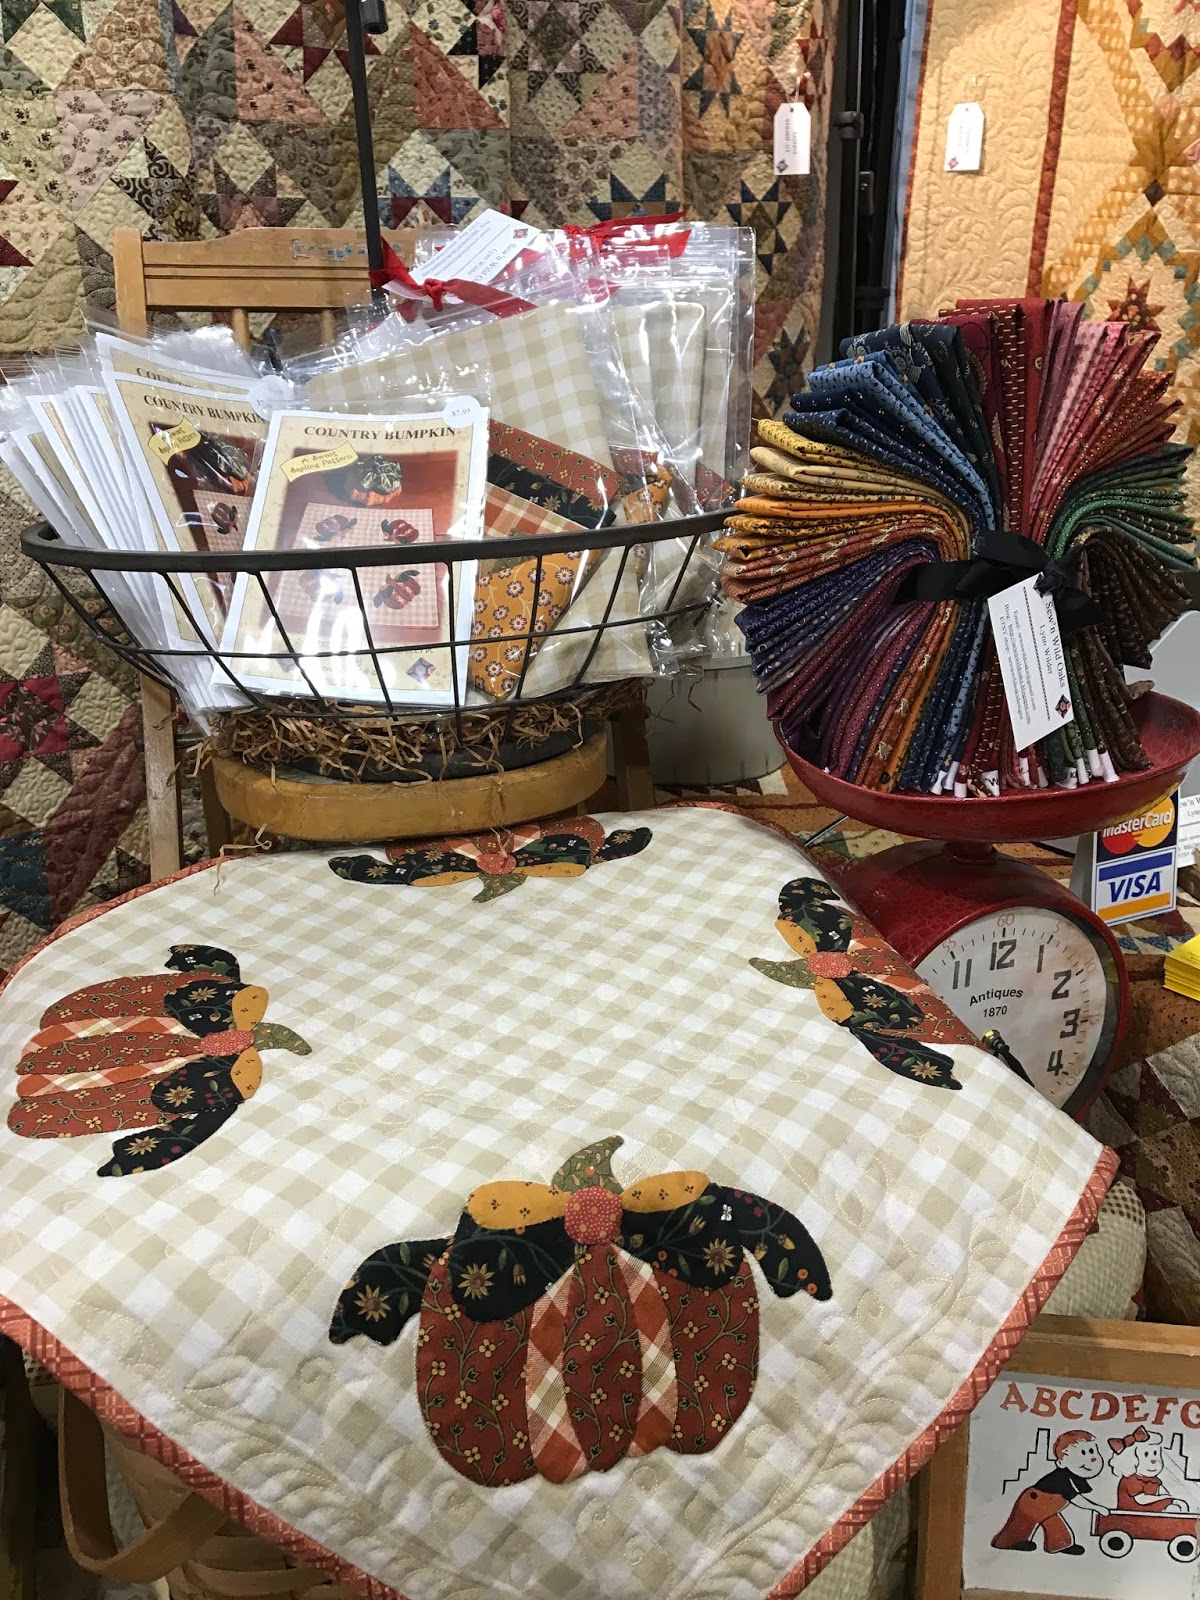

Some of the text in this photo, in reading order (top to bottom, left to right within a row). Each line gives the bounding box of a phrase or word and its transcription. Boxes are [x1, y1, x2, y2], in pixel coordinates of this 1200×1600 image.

[143, 394, 204, 418] COUNTRY
[304, 426, 456, 440] COUNTRY BUMPKIN
[290, 454, 354, 474] Sapling Pattern
[312, 451, 338, 462] Sweet
[1039, 624, 1053, 675] Lynn Wilder
[1045, 601, 1066, 688] Sew'n Wild Oaks
[1102, 809, 1173, 837] MasterCard
[1108, 871, 1161, 902] VISA
[997, 913, 1015, 927] 60
[989, 939, 1017, 971] 12
[1036, 944, 1045, 973] 1
[952, 958, 973, 990] 11
[1051, 969, 1072, 1000] 2
[969, 987, 1024, 1006] Antiques
[982, 1005, 1008, 1018] 1870
[1060, 1008, 1081, 1039] 3
[1046, 1049, 1064, 1077] 4
[1000, 1382, 1200, 1430] ABCDEFG
